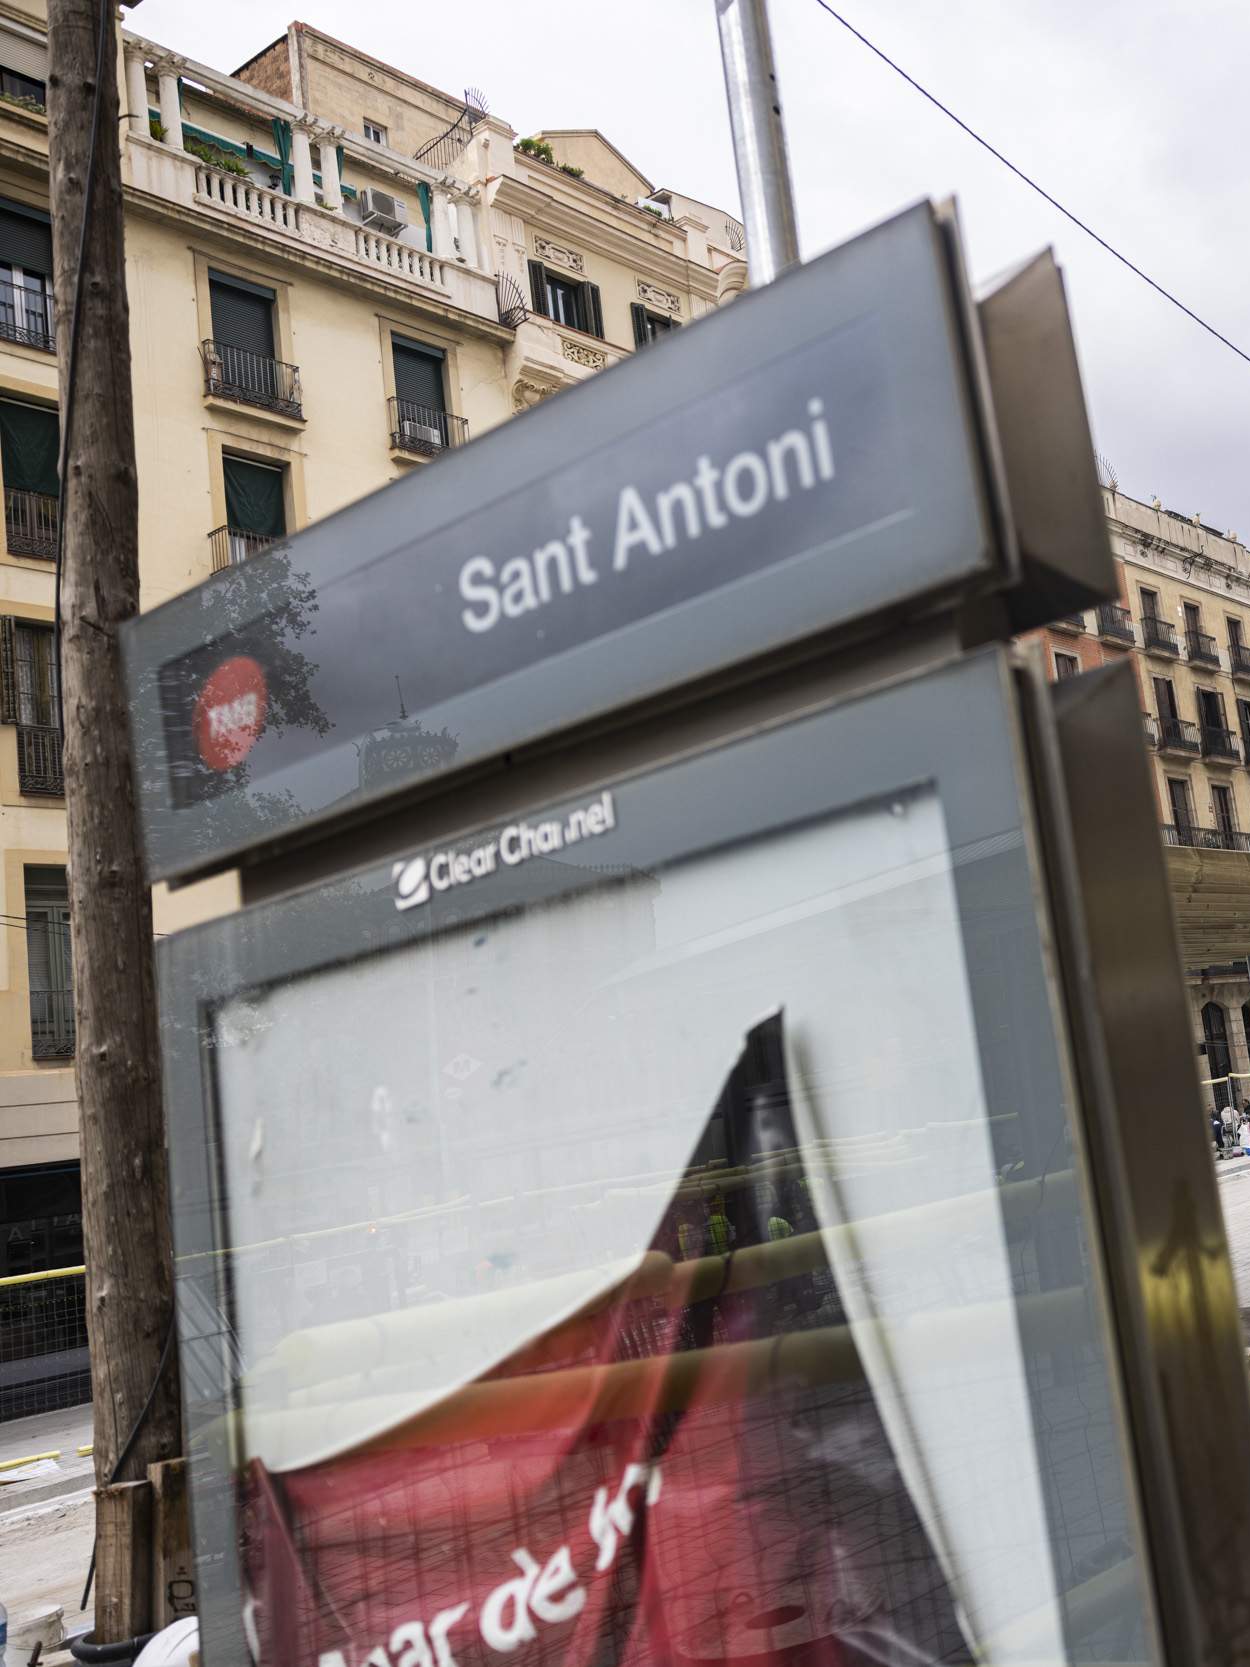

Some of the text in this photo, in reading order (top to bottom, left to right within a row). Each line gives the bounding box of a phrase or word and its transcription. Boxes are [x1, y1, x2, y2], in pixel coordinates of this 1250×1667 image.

[458, 398, 836, 634] Sant Antoni
[430, 841, 498, 891] Clear
[480, 1547, 587, 1651] de
